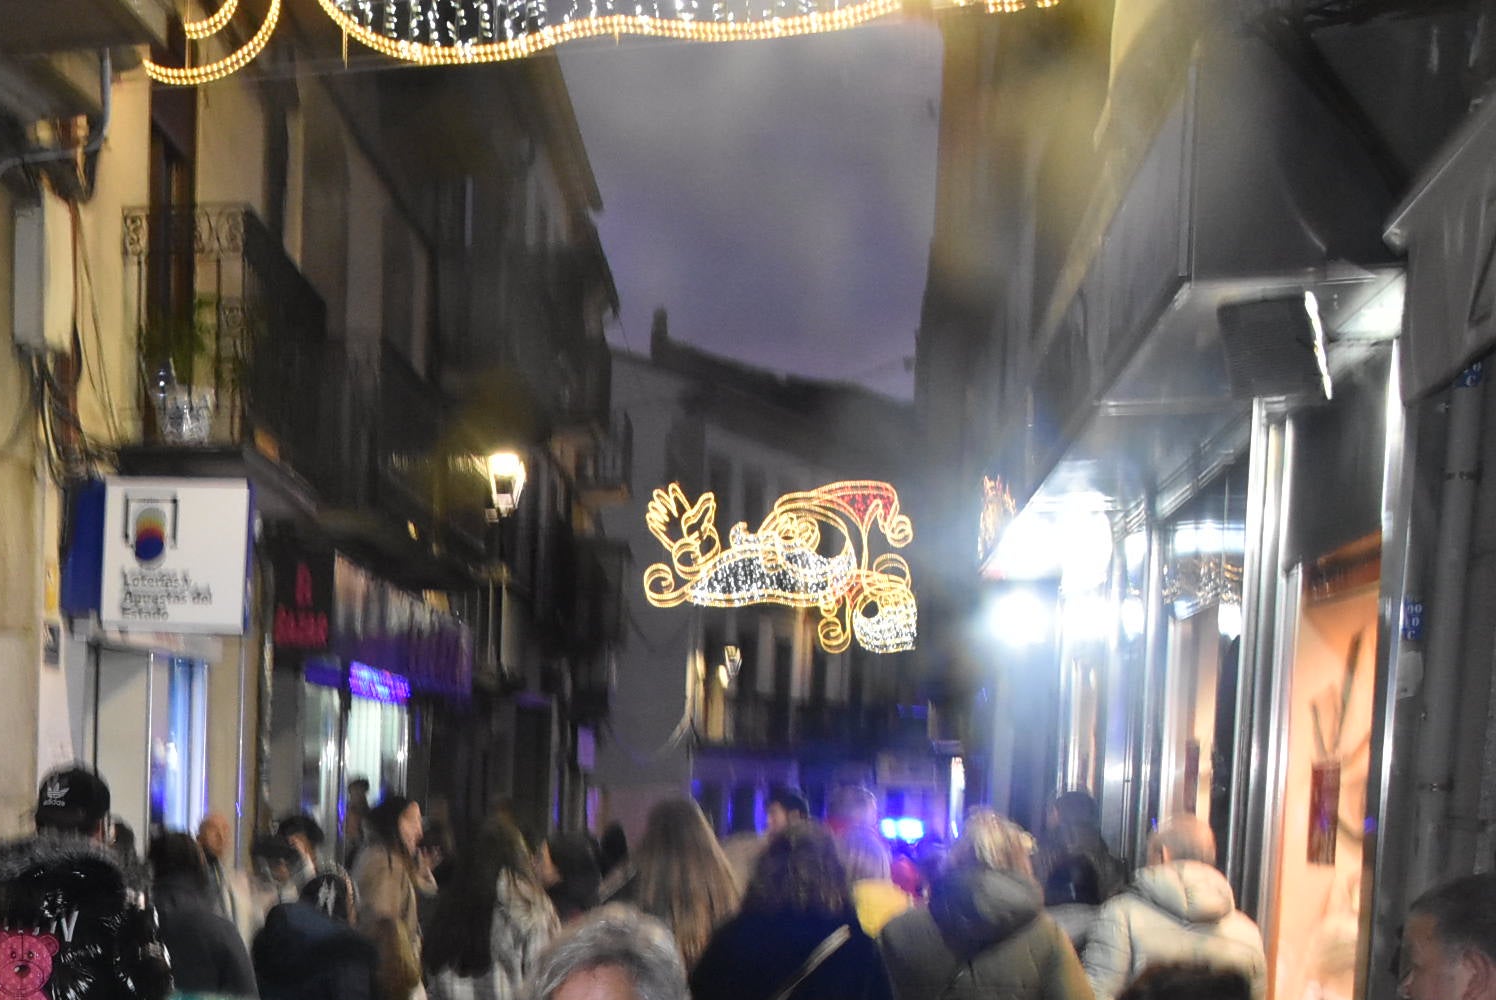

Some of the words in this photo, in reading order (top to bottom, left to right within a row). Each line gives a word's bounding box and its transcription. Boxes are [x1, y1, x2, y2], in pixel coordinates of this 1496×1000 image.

[123, 590, 188, 607] Apuestas
[191, 585, 213, 605] del
[121, 604, 169, 620] Estado
